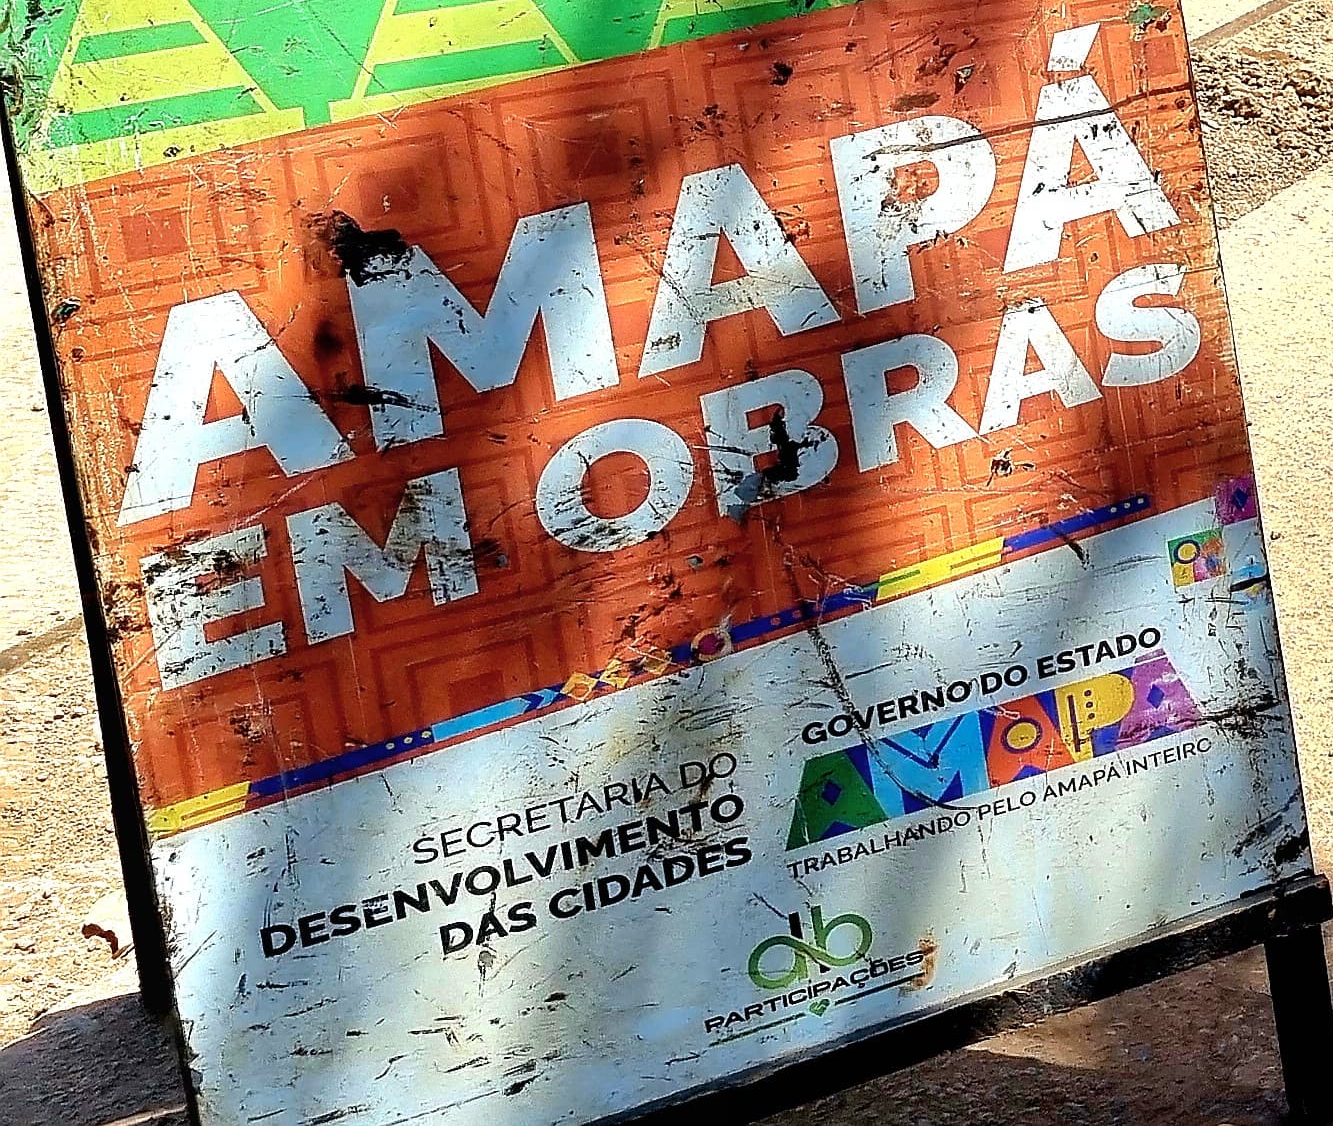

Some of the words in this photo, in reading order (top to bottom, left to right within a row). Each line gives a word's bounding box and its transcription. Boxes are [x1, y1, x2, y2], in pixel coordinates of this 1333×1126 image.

[117, 23, 1181, 528] AMAPÁ
[139, 467, 479, 691] EM
[535, 263, 1201, 553] OBRAS
[801, 680, 971, 745] GOVERNO
[980, 665, 1028, 695] DO
[1036, 627, 1161, 680] ESTADO
[412, 770, 670, 865] SECRETARIA
[680, 751, 737, 789] DO
[784, 647, 1211, 851] AMAPÁ
[260, 792, 745, 959] DESENVOLVIMENTO
[786, 810, 971, 880] TRABALHANDO
[977, 790, 1036, 820] PELO
[1043, 760, 1121, 802] AMAPÁ
[439, 901, 538, 956] DAS
[548, 836, 753, 920] CIDADES
[703, 949, 924, 1034] PARTICIPAÇÕES
